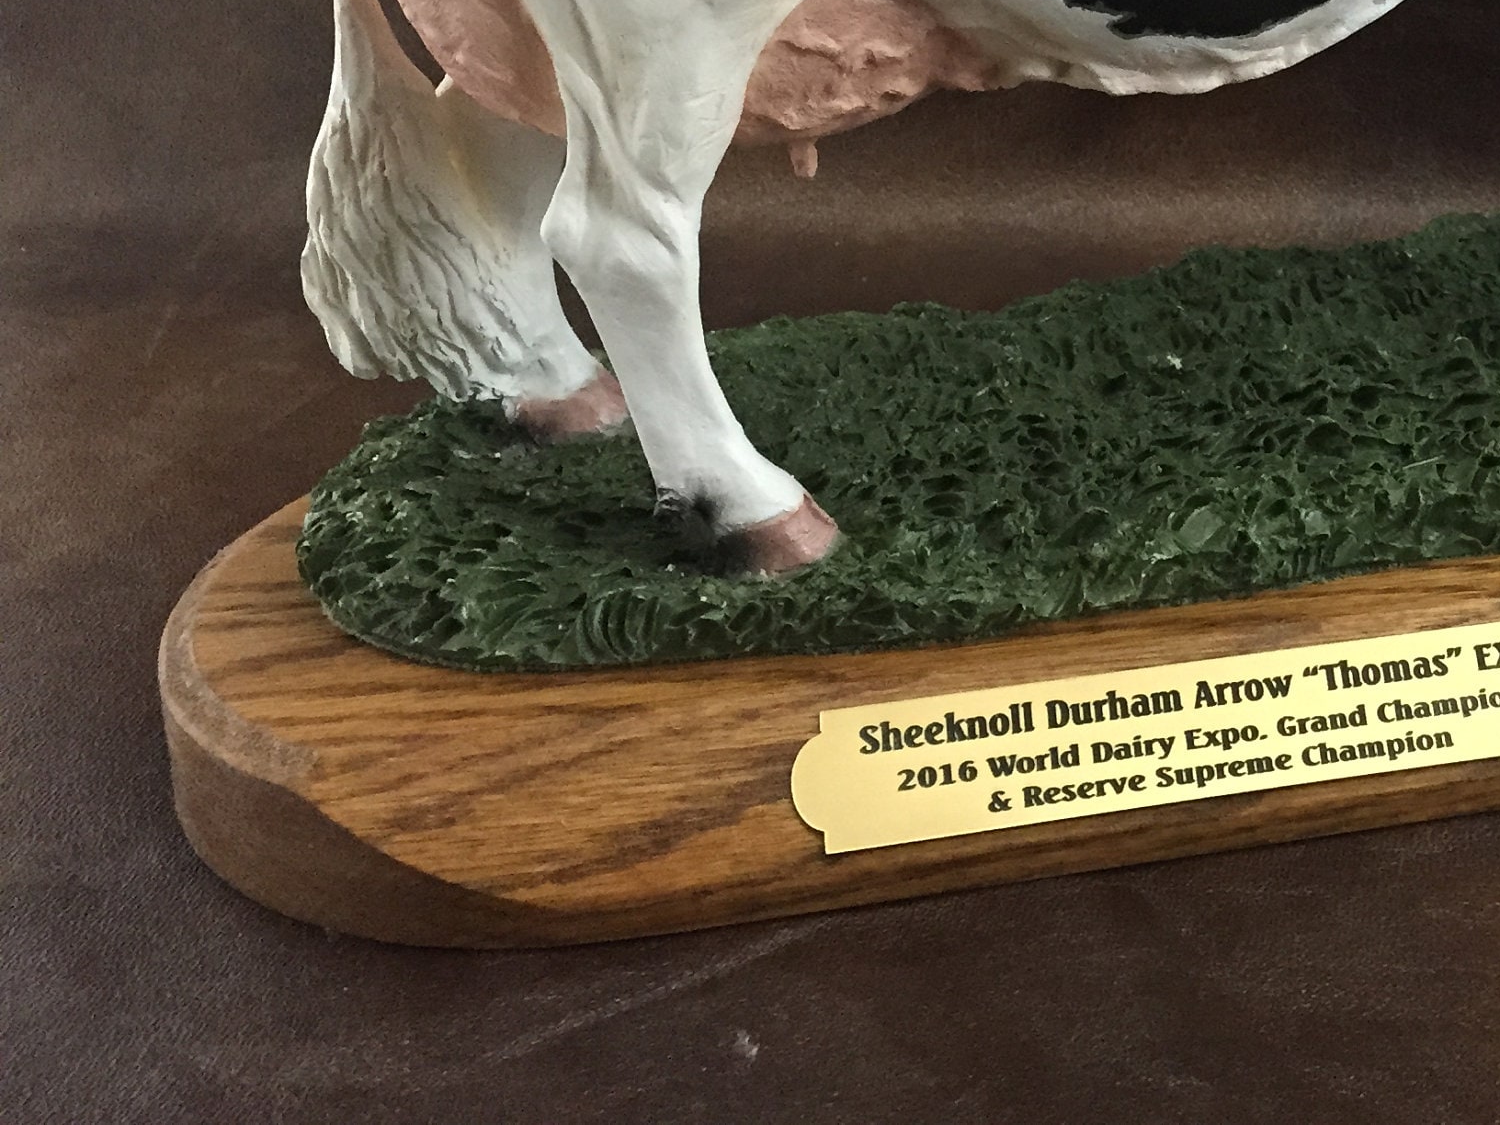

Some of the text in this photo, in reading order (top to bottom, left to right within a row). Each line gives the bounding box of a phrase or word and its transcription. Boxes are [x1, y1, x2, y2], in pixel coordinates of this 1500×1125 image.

[858, 701, 1036, 755] Sheeknoll
[1044, 689, 1184, 730] Durham
[1194, 674, 1293, 710] Arrow
[1302, 646, 1462, 691] “Thomas”
[896, 760, 978, 792] 2016
[985, 743, 1081, 778] World
[1090, 734, 1176, 764] Dairy
[1183, 724, 1268, 751] Expo.
[1276, 703, 1368, 737] Grand
[987, 730, 1455, 813] & Reserve Supreme Champion
